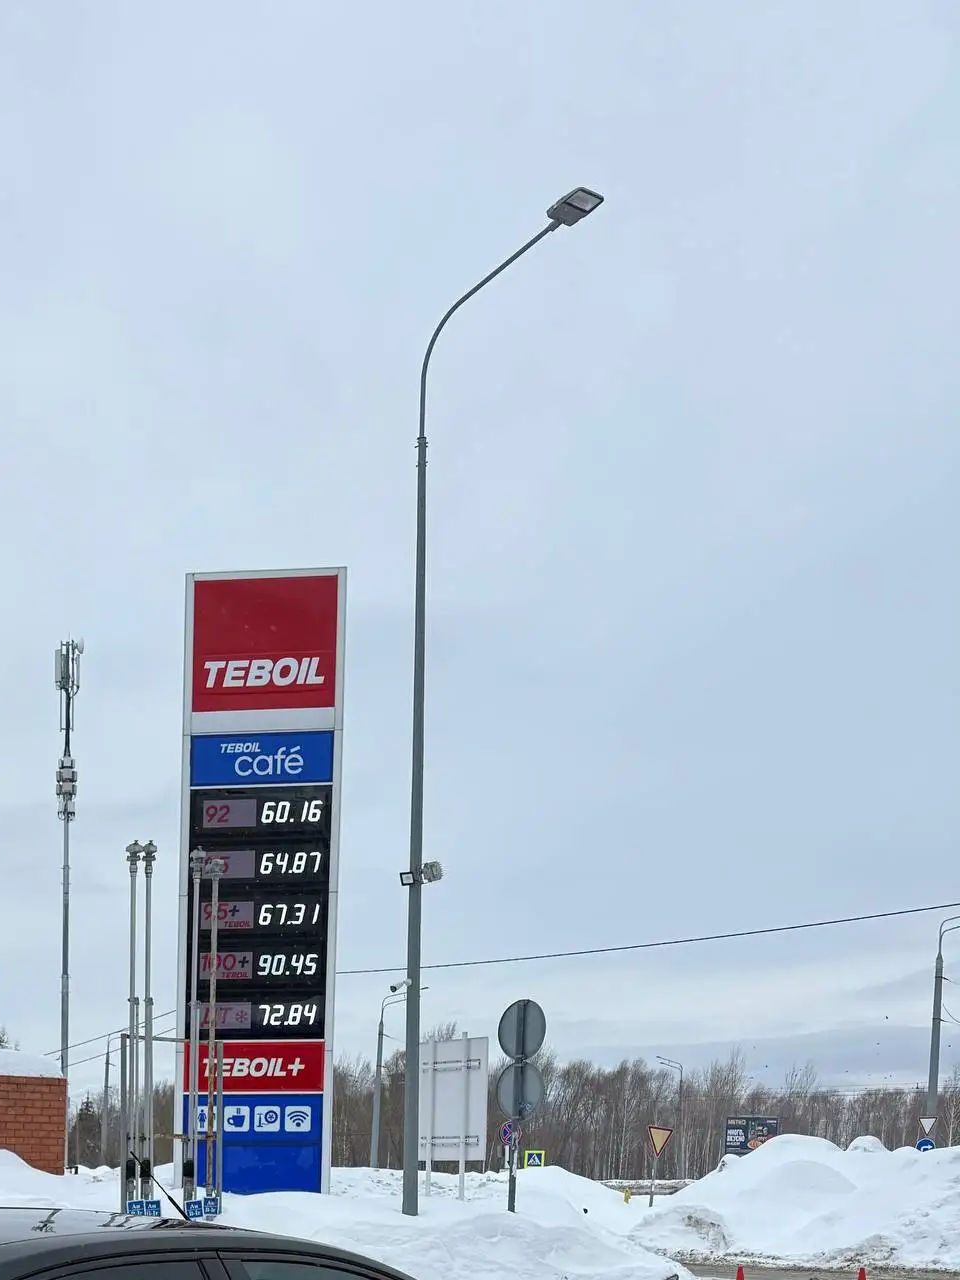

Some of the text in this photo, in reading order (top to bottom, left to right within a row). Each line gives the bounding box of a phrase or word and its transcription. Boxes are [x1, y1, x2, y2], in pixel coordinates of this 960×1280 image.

[204, 657, 325, 688] TEBOIL
[220, 742, 261, 753] TEBOIL
[235, 746, 304, 776] café
[206, 800, 323, 823] 92 60.16
[260, 852, 321, 874] 64.87
[258, 904, 320, 925] 67.31
[257, 954, 318, 975] 90.45
[259, 1004, 316, 1025] 72.84
